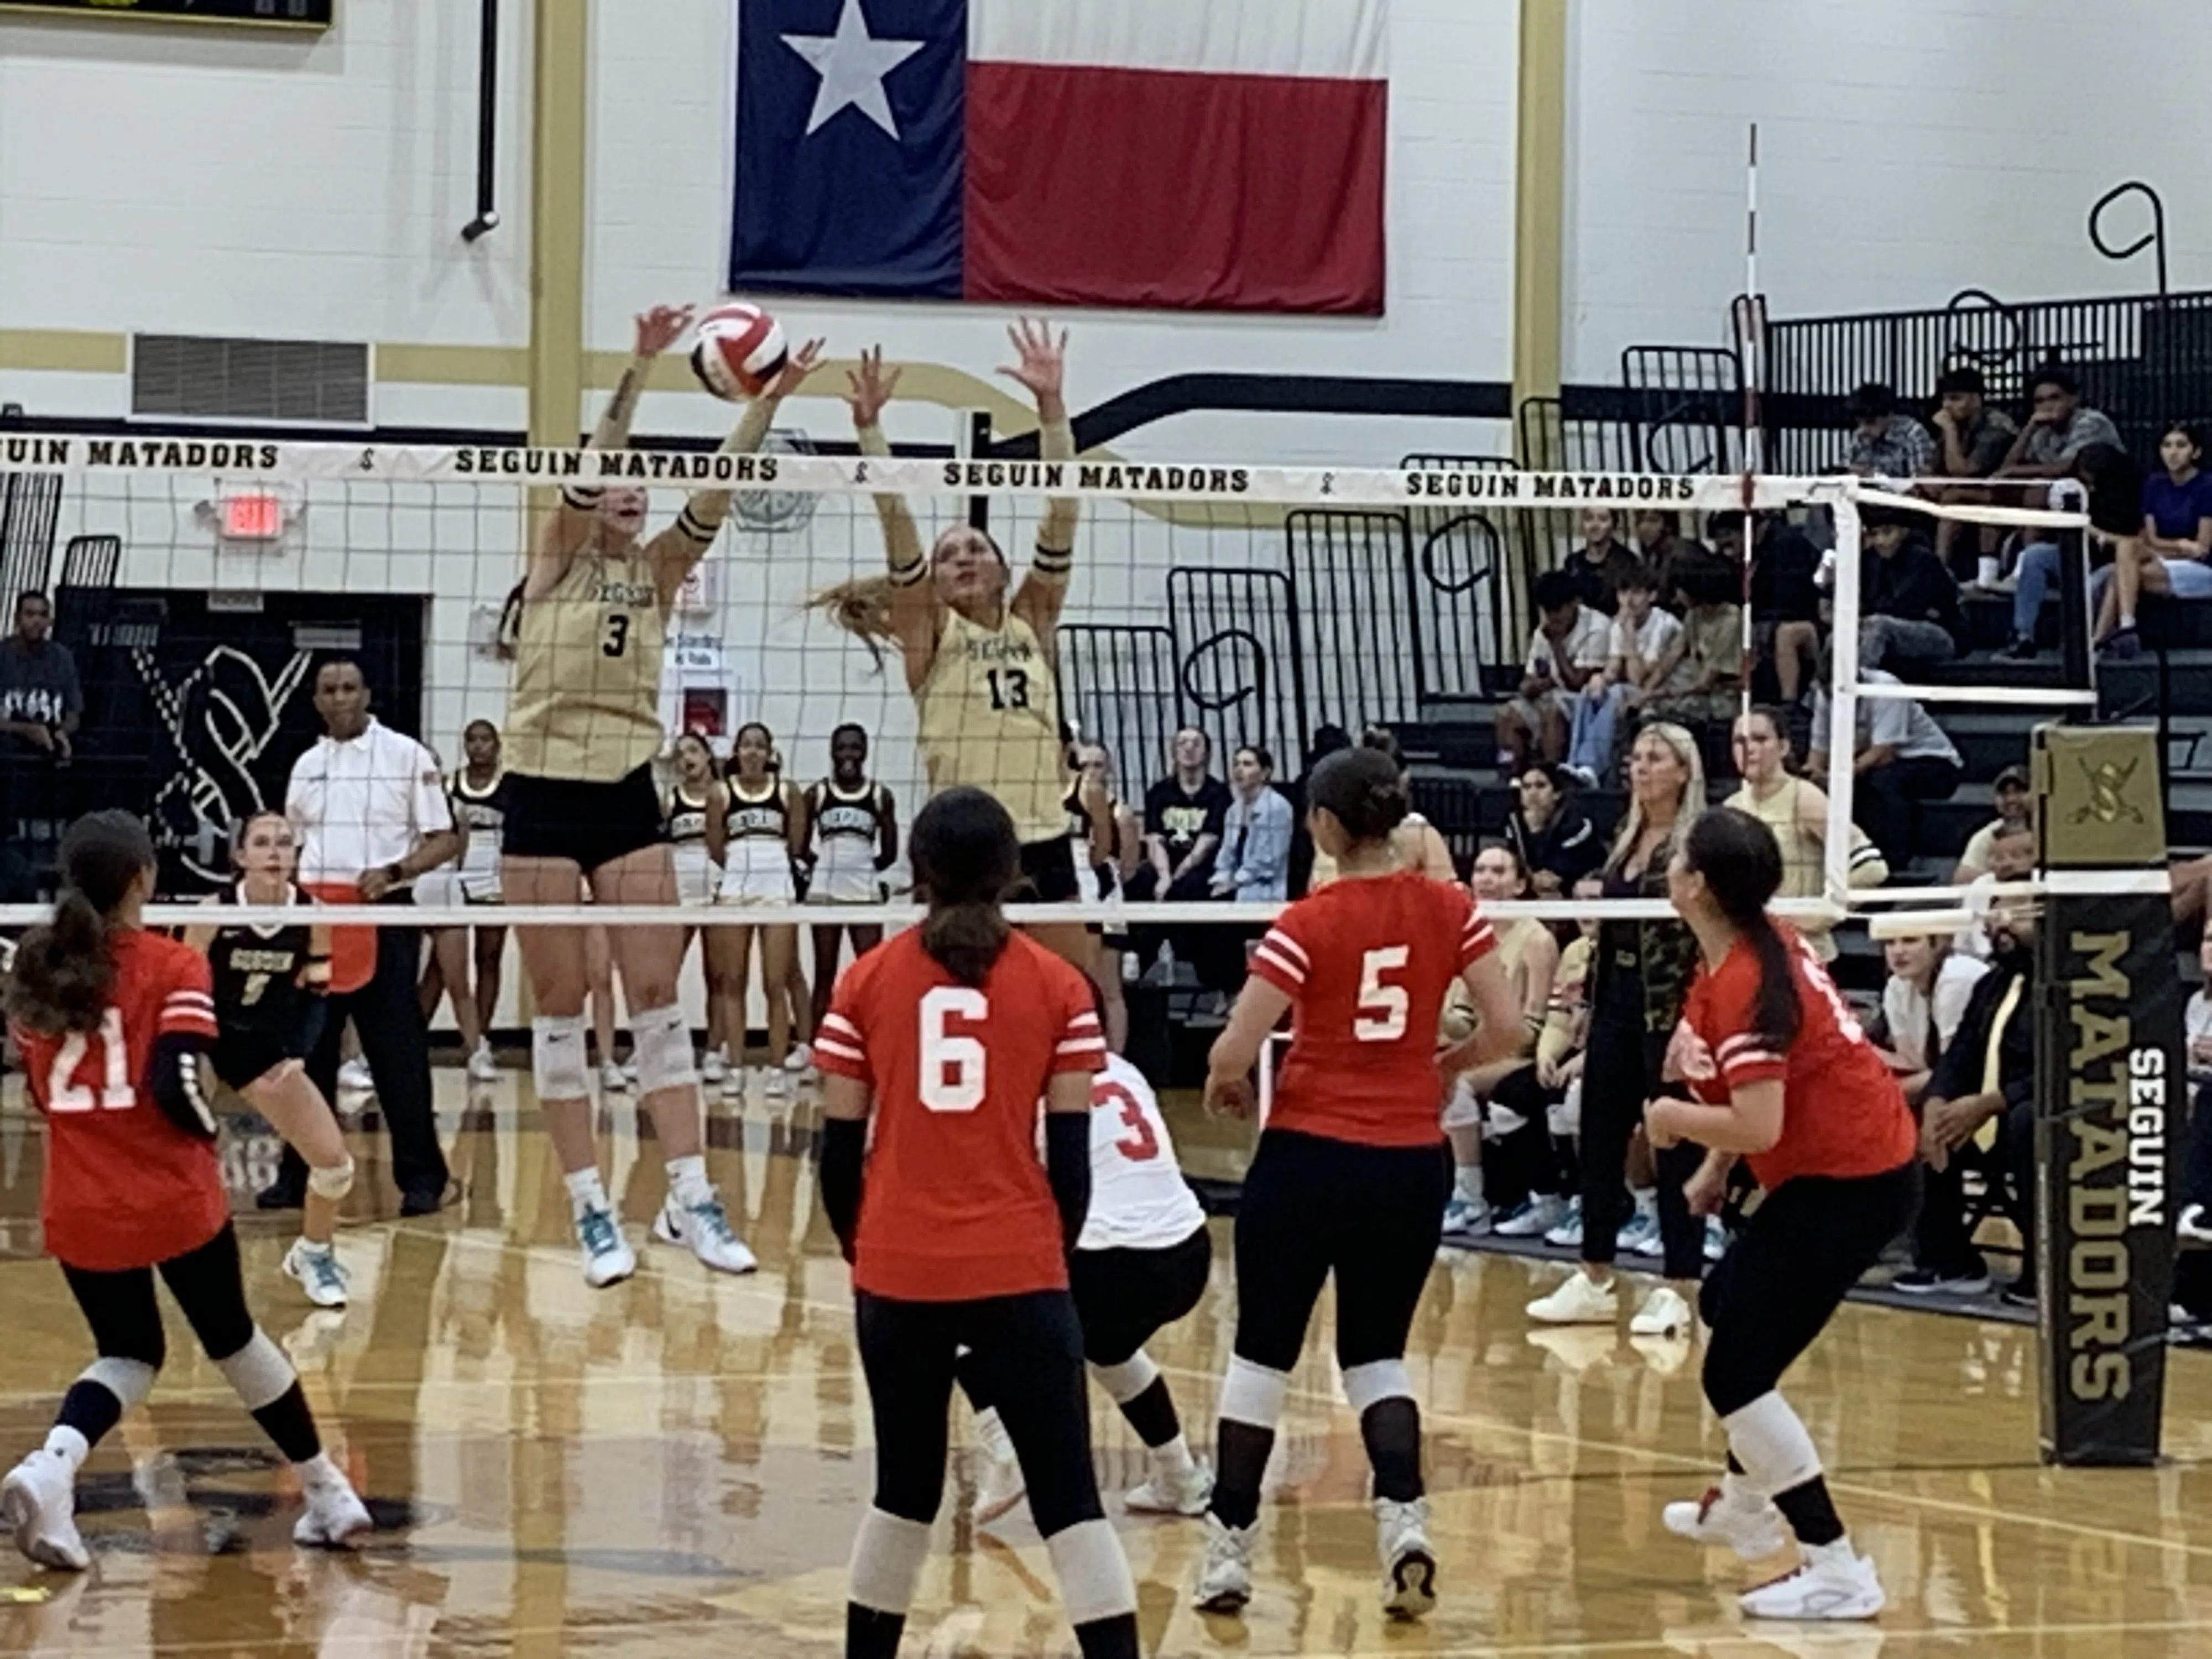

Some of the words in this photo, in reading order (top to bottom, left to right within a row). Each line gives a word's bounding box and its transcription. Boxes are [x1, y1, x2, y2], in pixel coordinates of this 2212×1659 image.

[0, 439, 69, 465] UIN
[87, 440, 279, 469] MATADORS
[455, 448, 582, 476] SEGUIN
[600, 452, 778, 481] MATADORS
[943, 462, 1063, 488] SEGUIN
[1078, 466, 1249, 493] MATADORS
[1406, 473, 1519, 498] SEGUIN
[1533, 474, 1694, 500] MATADORS
[603, 615, 629, 657] 3
[988, 669, 1029, 711] 13
[1354, 945, 1410, 1042] 5
[49, 1006, 137, 1112] 21
[919, 985, 988, 1113] 6
[1089, 1081, 1159, 1161] 3
[2128, 1047, 2165, 1227] SEGUIN
[2069, 931, 2131, 1401] MATADORS
